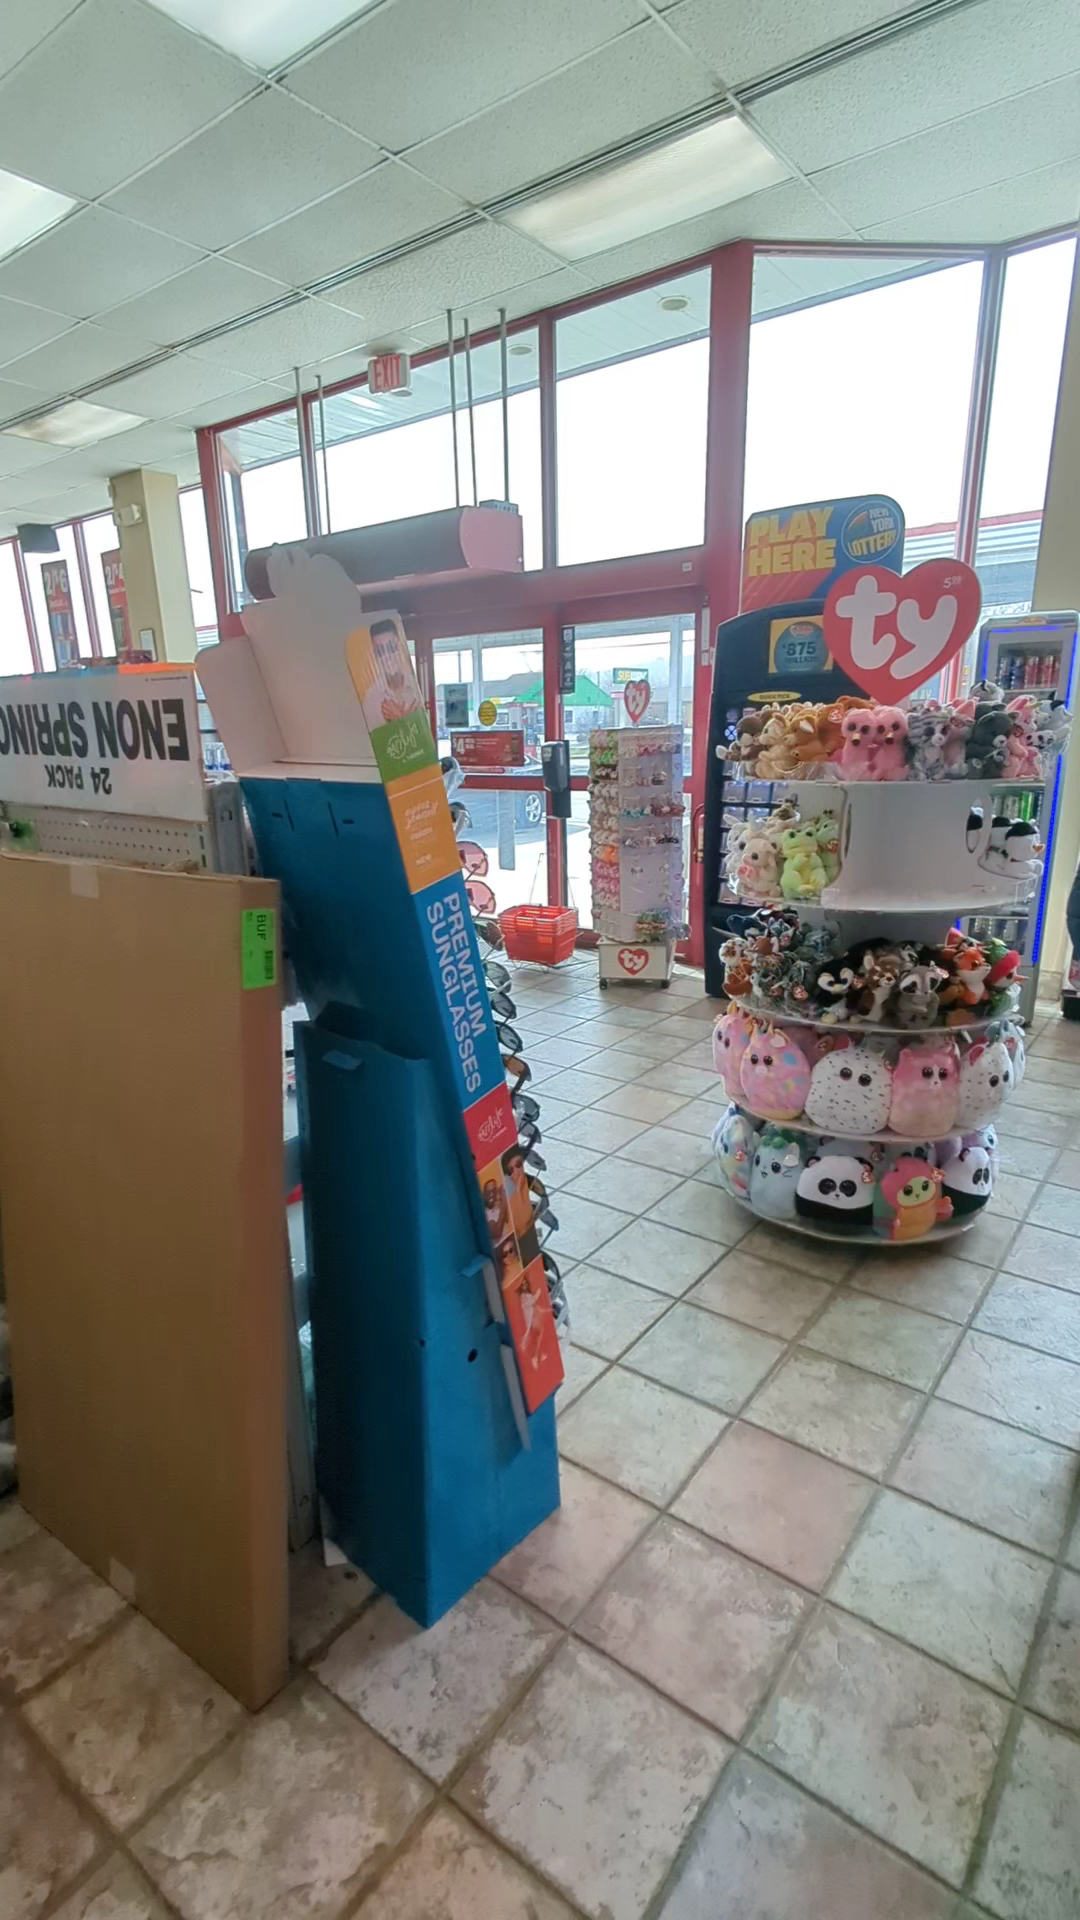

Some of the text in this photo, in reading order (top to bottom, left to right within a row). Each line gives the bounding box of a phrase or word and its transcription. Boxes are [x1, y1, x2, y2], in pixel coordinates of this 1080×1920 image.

[373, 356, 401, 391] EXIT
[750, 506, 835, 547] PLAY
[869, 507, 889, 519] NEW
[871, 517, 895, 534] YORK
[748, 538, 836, 577] HERE
[848, 530, 896, 557] LOTTERY
[835, 575, 958, 680] ty
[626, 683, 646, 716] ty
[92, 698, 190, 762] ENON
[44, 763, 112, 795] 24 PACK
[256, 914, 267, 941] BUF
[443, 891, 487, 1038] PREMIUM
[620, 949, 646, 971] ty
[427, 901, 482, 1094] SUNGLASSES
